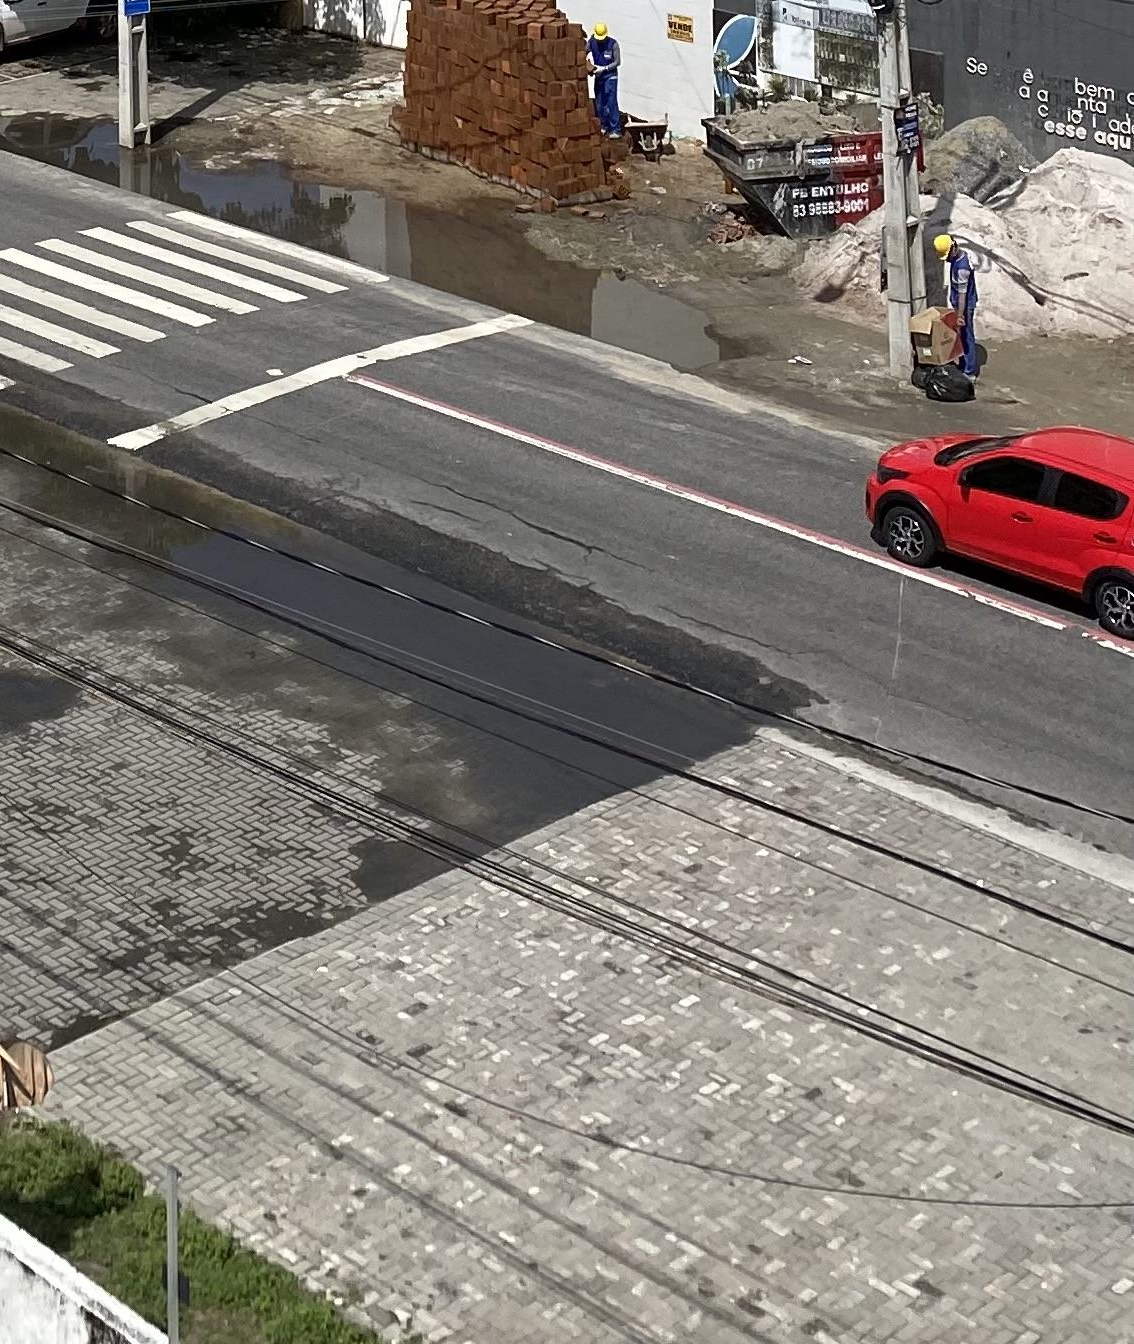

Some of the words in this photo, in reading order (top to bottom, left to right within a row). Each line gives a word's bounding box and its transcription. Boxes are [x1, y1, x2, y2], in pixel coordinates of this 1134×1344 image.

[965, 55, 989, 77] Se
[1073, 76, 1115, 102] bem
[1043, 120, 1088, 141] esse
